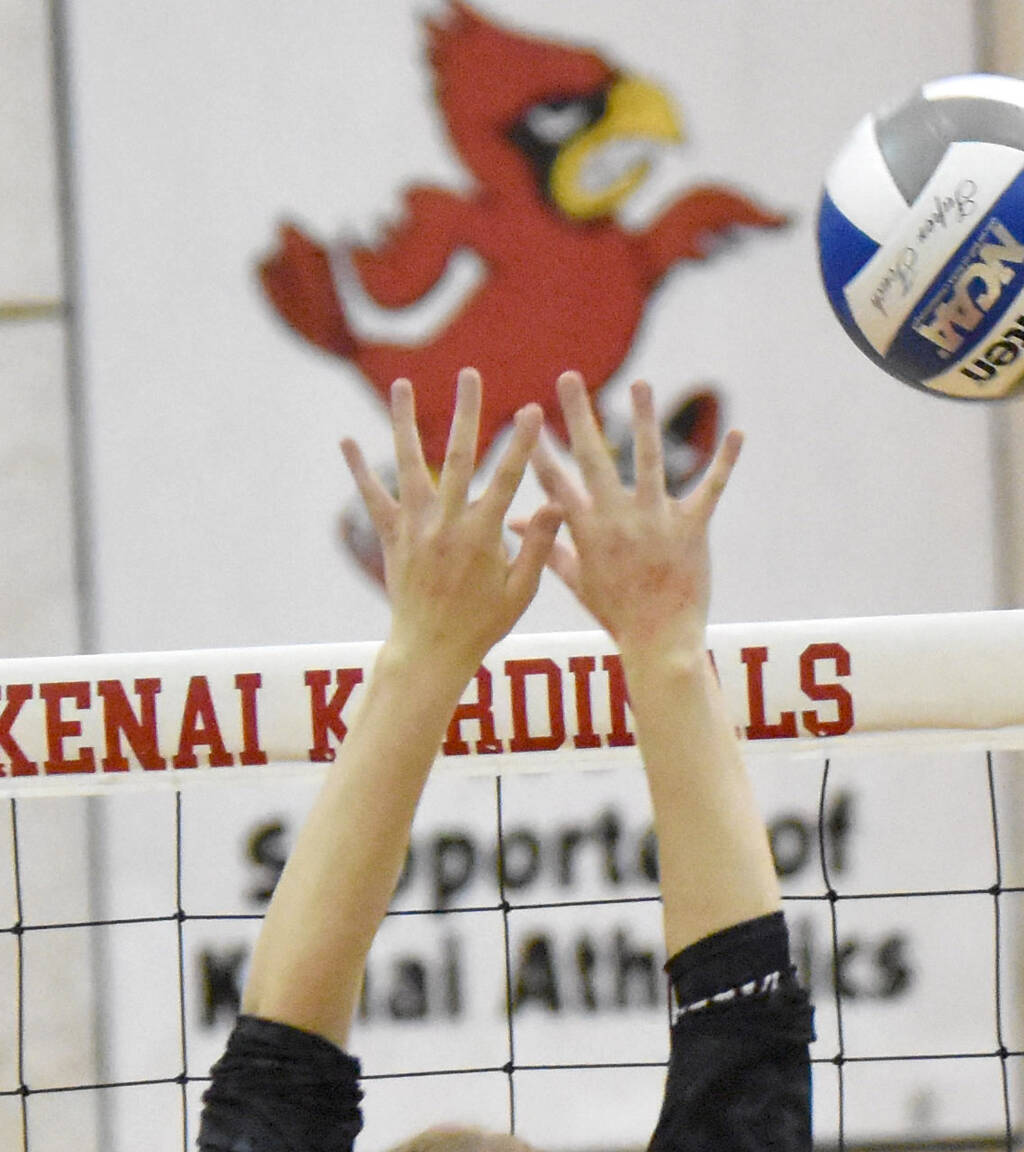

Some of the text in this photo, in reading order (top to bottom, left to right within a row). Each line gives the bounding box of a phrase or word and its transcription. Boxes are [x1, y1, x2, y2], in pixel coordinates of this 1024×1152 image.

[0, 642, 855, 777] KENAI KRDILS
[765, 785, 857, 880] of
[198, 918, 914, 1030] Kai Athics
